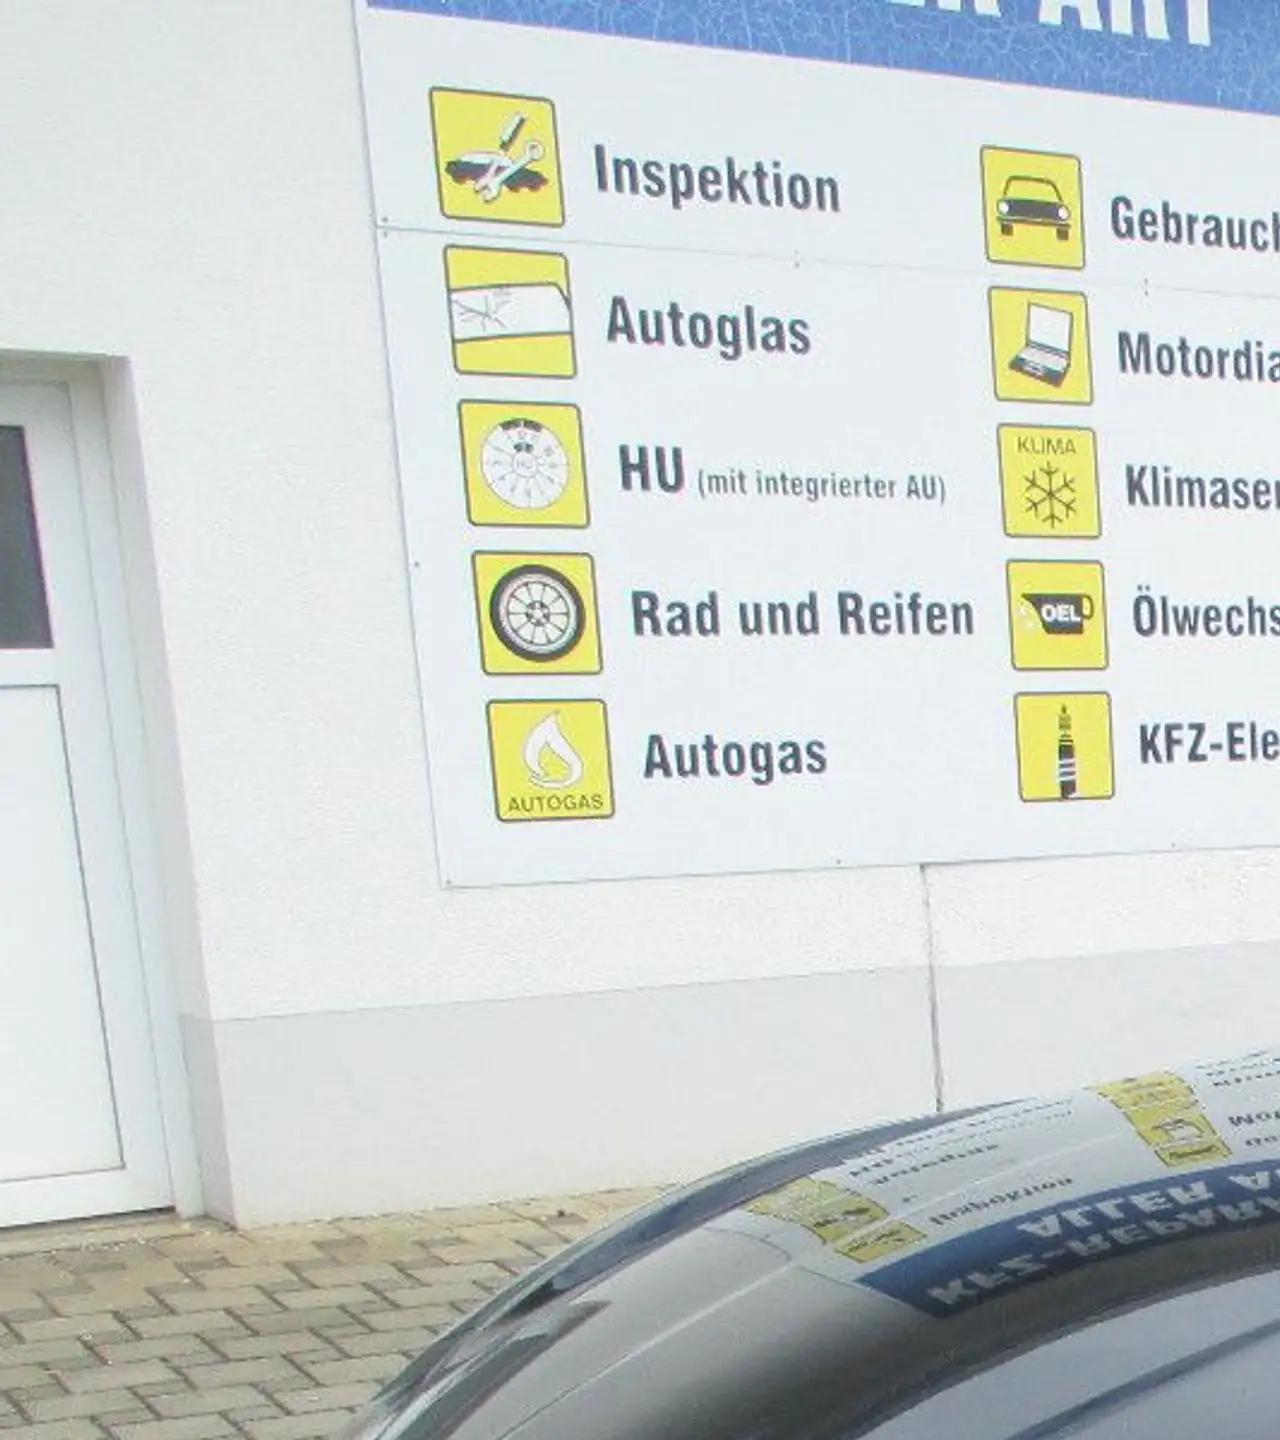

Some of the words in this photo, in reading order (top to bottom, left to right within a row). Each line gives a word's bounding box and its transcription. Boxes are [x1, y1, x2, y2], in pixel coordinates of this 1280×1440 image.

[594, 143, 840, 213] Inspektion
[607, 295, 811, 361] Autoglas
[1017, 435, 1077, 455] KLIMA
[619, 444, 685, 493] HU
[698, 470, 746, 497] (mit
[756, 472, 895, 502] integrierter
[906, 475, 945, 504] AU)
[631, 590, 720, 637] Rad
[739, 591, 820, 637] und
[837, 591, 974, 635] Reifen
[1041, 604, 1082, 623] OEL
[643, 734, 827, 786] Autogas
[507, 793, 604, 812] AUTOGAS
